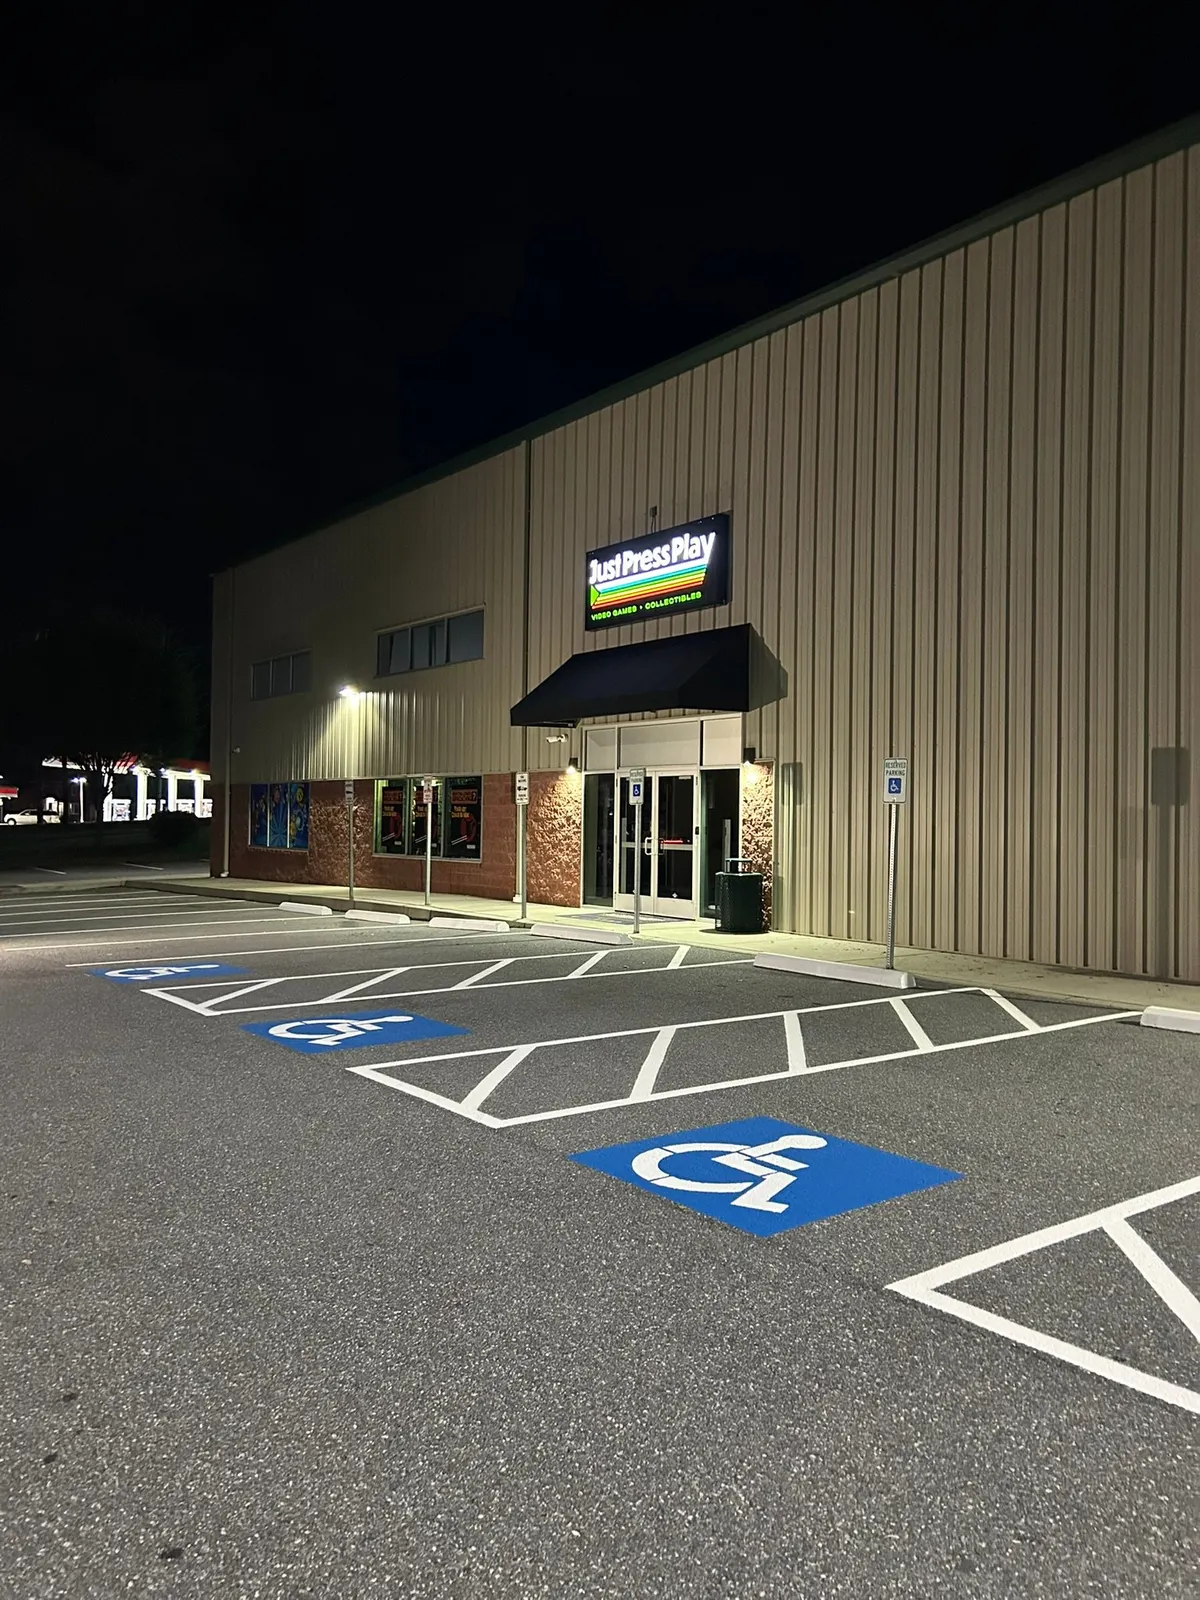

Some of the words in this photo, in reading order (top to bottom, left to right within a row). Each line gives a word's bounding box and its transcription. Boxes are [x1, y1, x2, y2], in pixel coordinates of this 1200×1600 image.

[622, 543, 671, 576] Press
[671, 531, 716, 565] Play
[591, 610, 611, 621] VIDEO
[612, 605, 637, 616] GAMES
[645, 591, 702, 610] COLLECTIBLES
